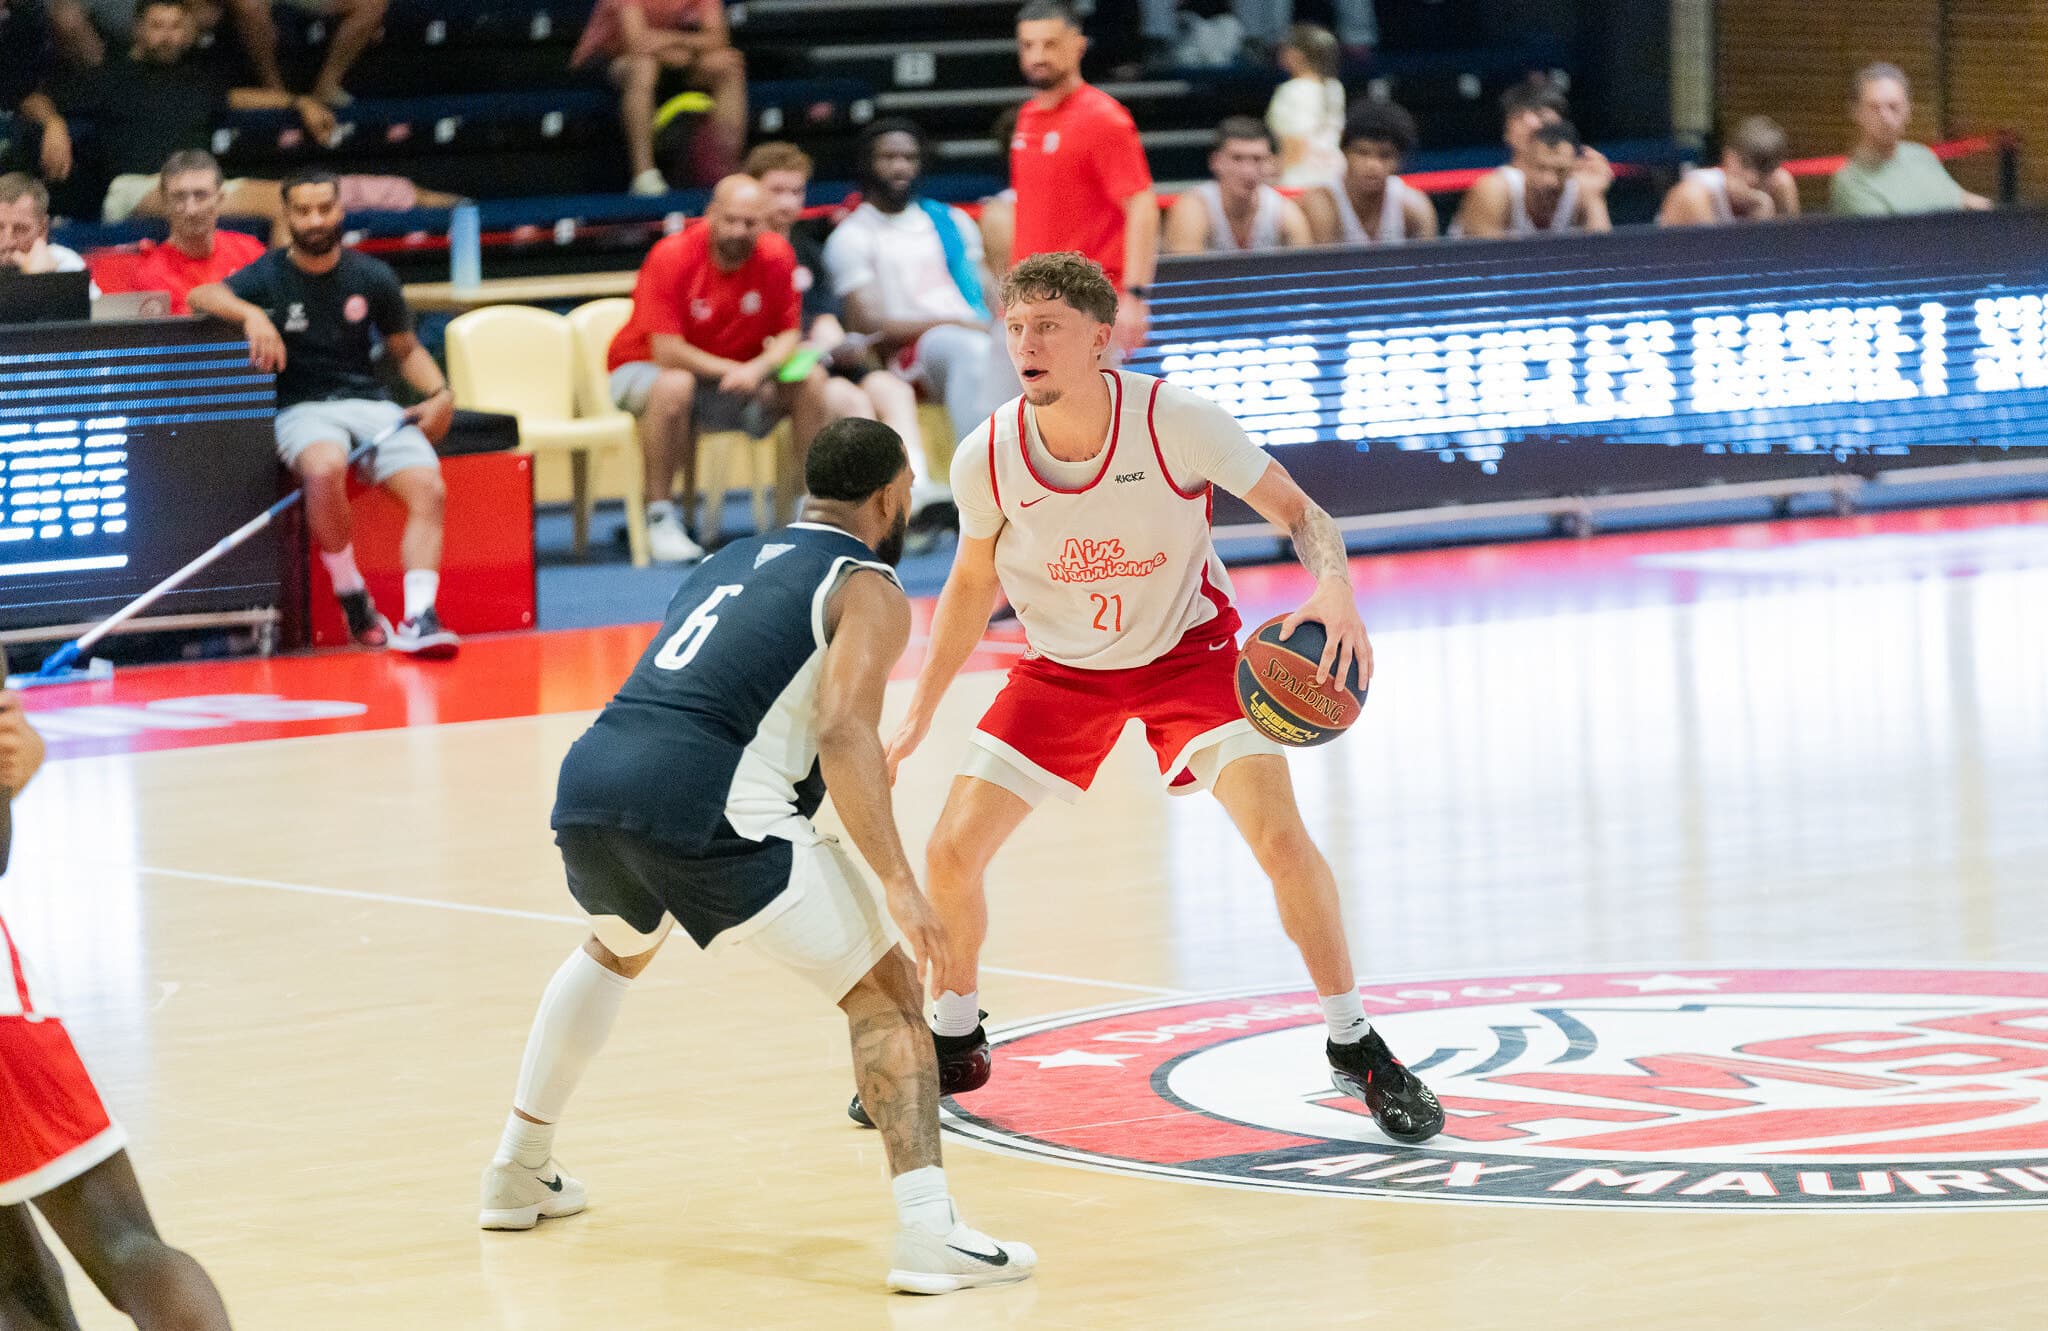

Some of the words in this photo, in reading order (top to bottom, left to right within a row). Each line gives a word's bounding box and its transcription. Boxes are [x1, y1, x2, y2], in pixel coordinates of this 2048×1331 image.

[1047, 552, 1167, 583] Maurienne
[1060, 537, 1125, 570] Aix
[654, 584, 744, 671] 6
[1089, 592, 1122, 632] 21
[1262, 657, 1346, 725] SPALDING
[1250, 690, 1321, 740] LEGACY
[1358, 982, 1564, 1006] 1969
[1249, 1152, 1536, 1188] AIX
[1546, 1165, 2048, 1198] MAURI
